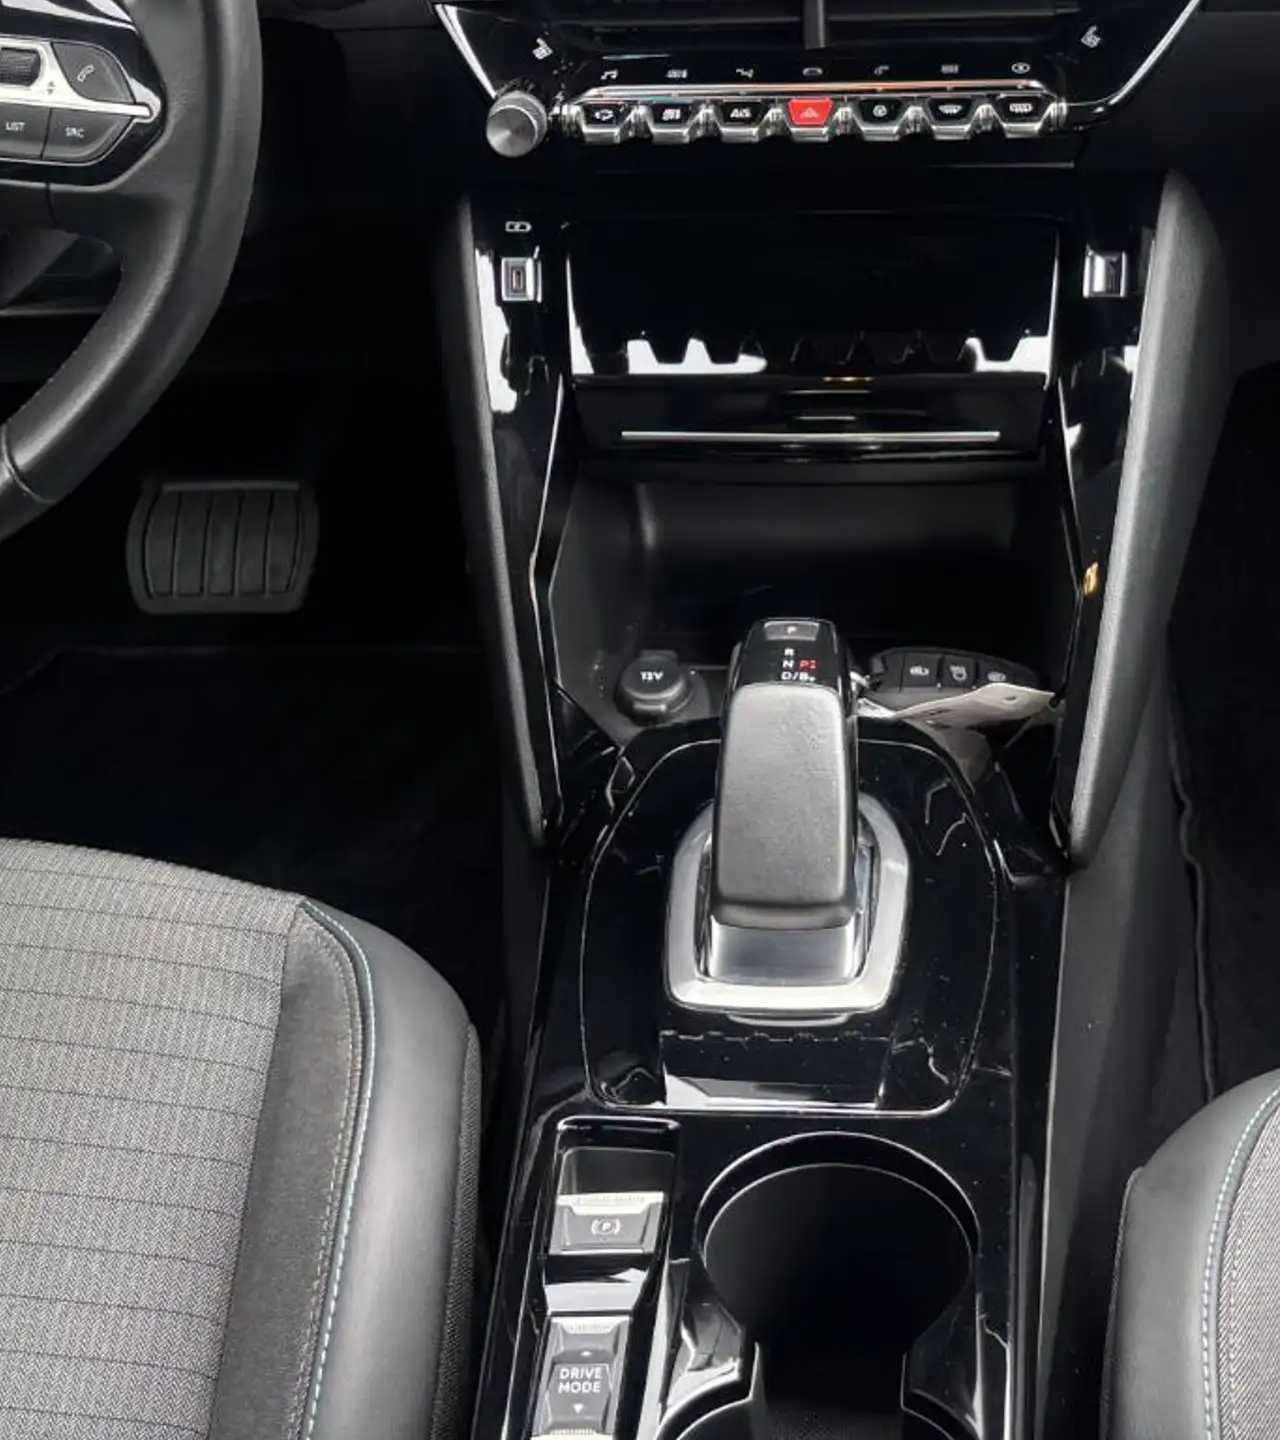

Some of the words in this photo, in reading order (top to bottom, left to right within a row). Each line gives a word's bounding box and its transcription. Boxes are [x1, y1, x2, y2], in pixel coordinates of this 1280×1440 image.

[5, 121, 26, 132] LIST
[787, 625, 797, 636] P
[782, 659, 795, 669] N
[640, 670, 664, 682] 12V
[558, 1367, 602, 1380] DRIVE
[557, 1381, 602, 1395] MODE
